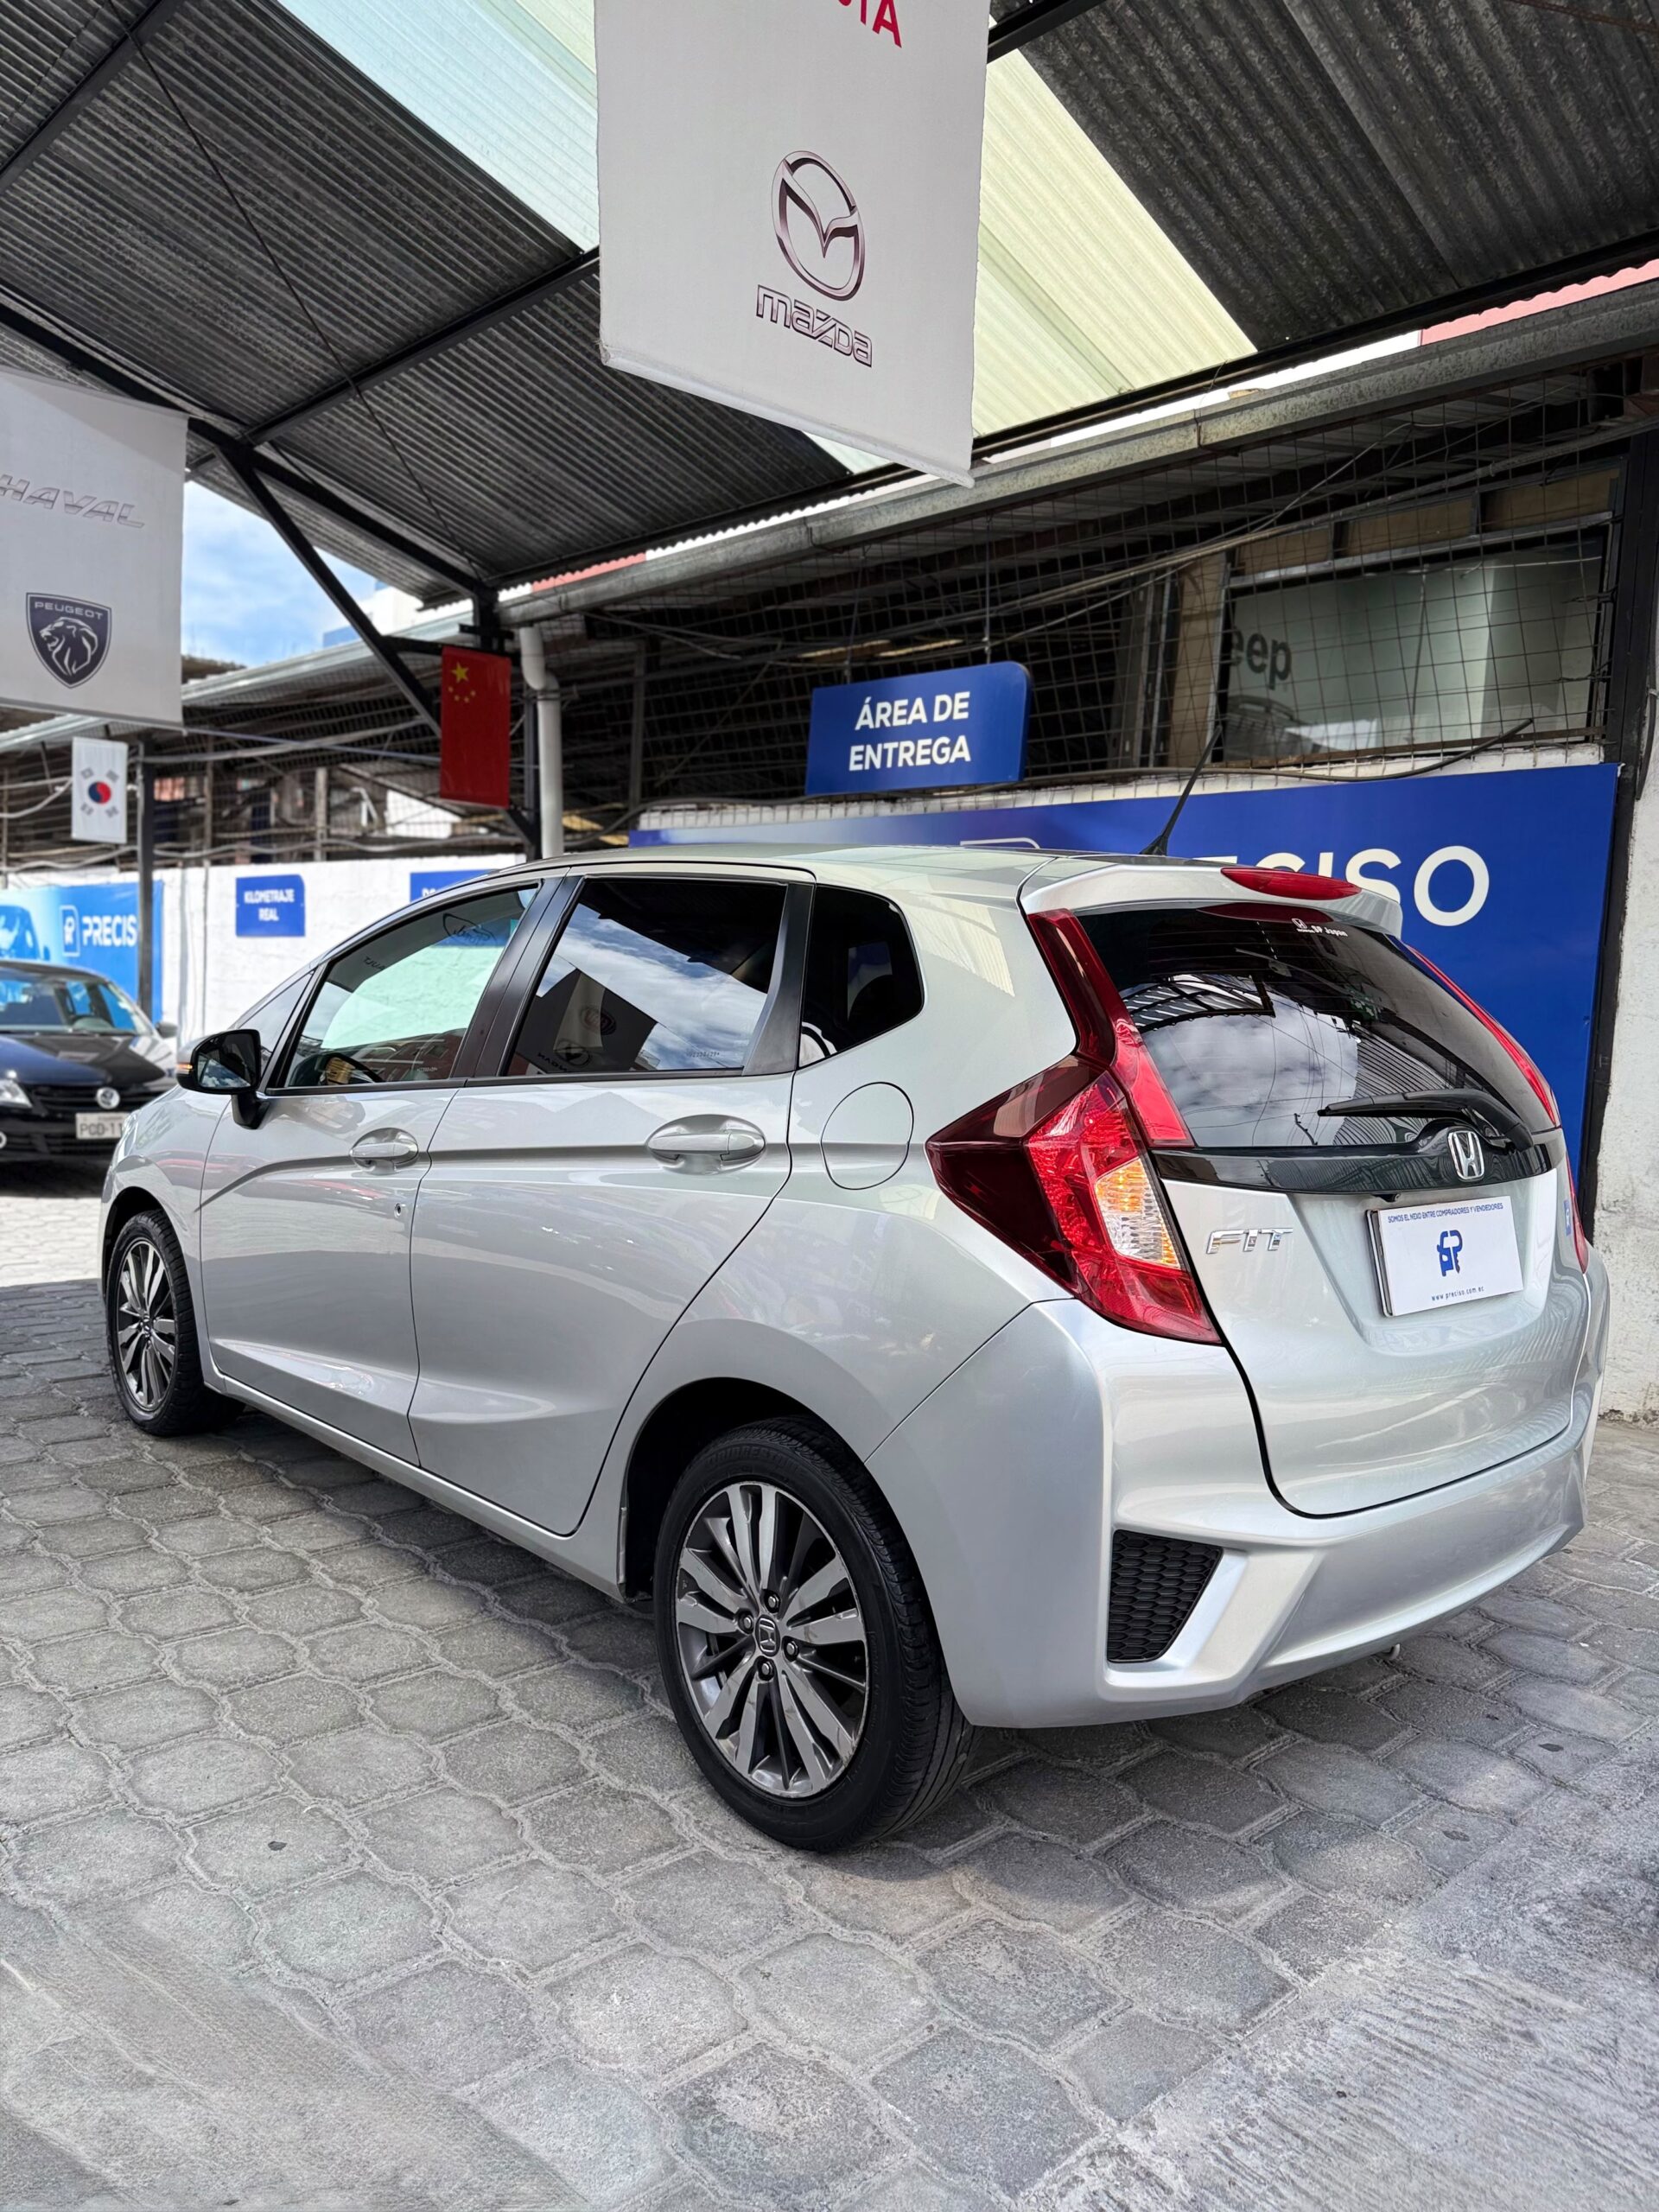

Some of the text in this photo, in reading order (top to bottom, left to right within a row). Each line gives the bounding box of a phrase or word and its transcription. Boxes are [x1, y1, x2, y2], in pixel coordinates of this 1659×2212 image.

[0, 474, 145, 529] HAVAL
[35, 601, 103, 620] PEUGEOT
[1230, 629, 1292, 690] eep
[855, 691, 970, 730] ÁREA DE
[849, 735, 971, 771] ENTREGA
[82, 914, 139, 947] PRECIS
[1388, 1215, 1404, 1224] SOMOS
[1422, 1210, 1436, 1218] ENTRE
[1436, 1207, 1470, 1217] COMPRADORES
[1473, 1202, 1503, 1212] VENDEDORES
[1206, 1228, 1294, 1246] FIT
